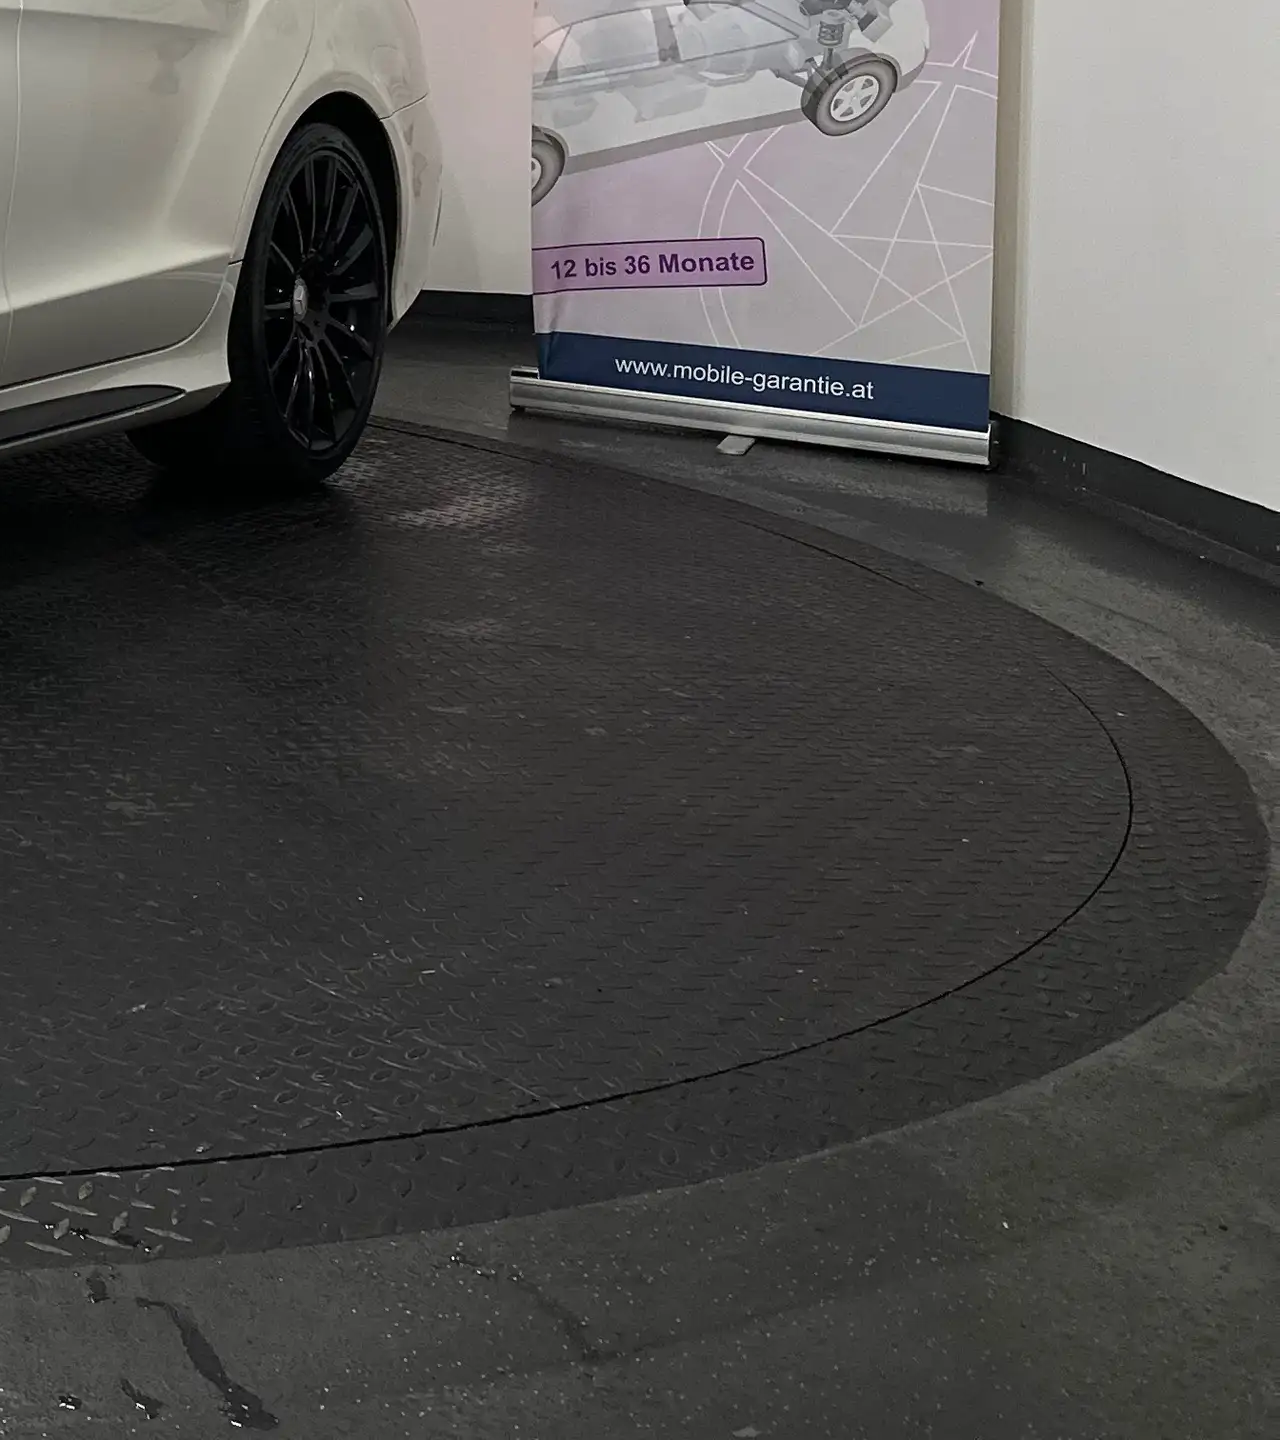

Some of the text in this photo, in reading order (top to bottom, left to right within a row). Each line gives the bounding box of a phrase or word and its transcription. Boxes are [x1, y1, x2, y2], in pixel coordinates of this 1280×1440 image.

[550, 252, 755, 280] 12 bis 36 Monate
[614, 356, 875, 401] www.mobile-garantie.at
